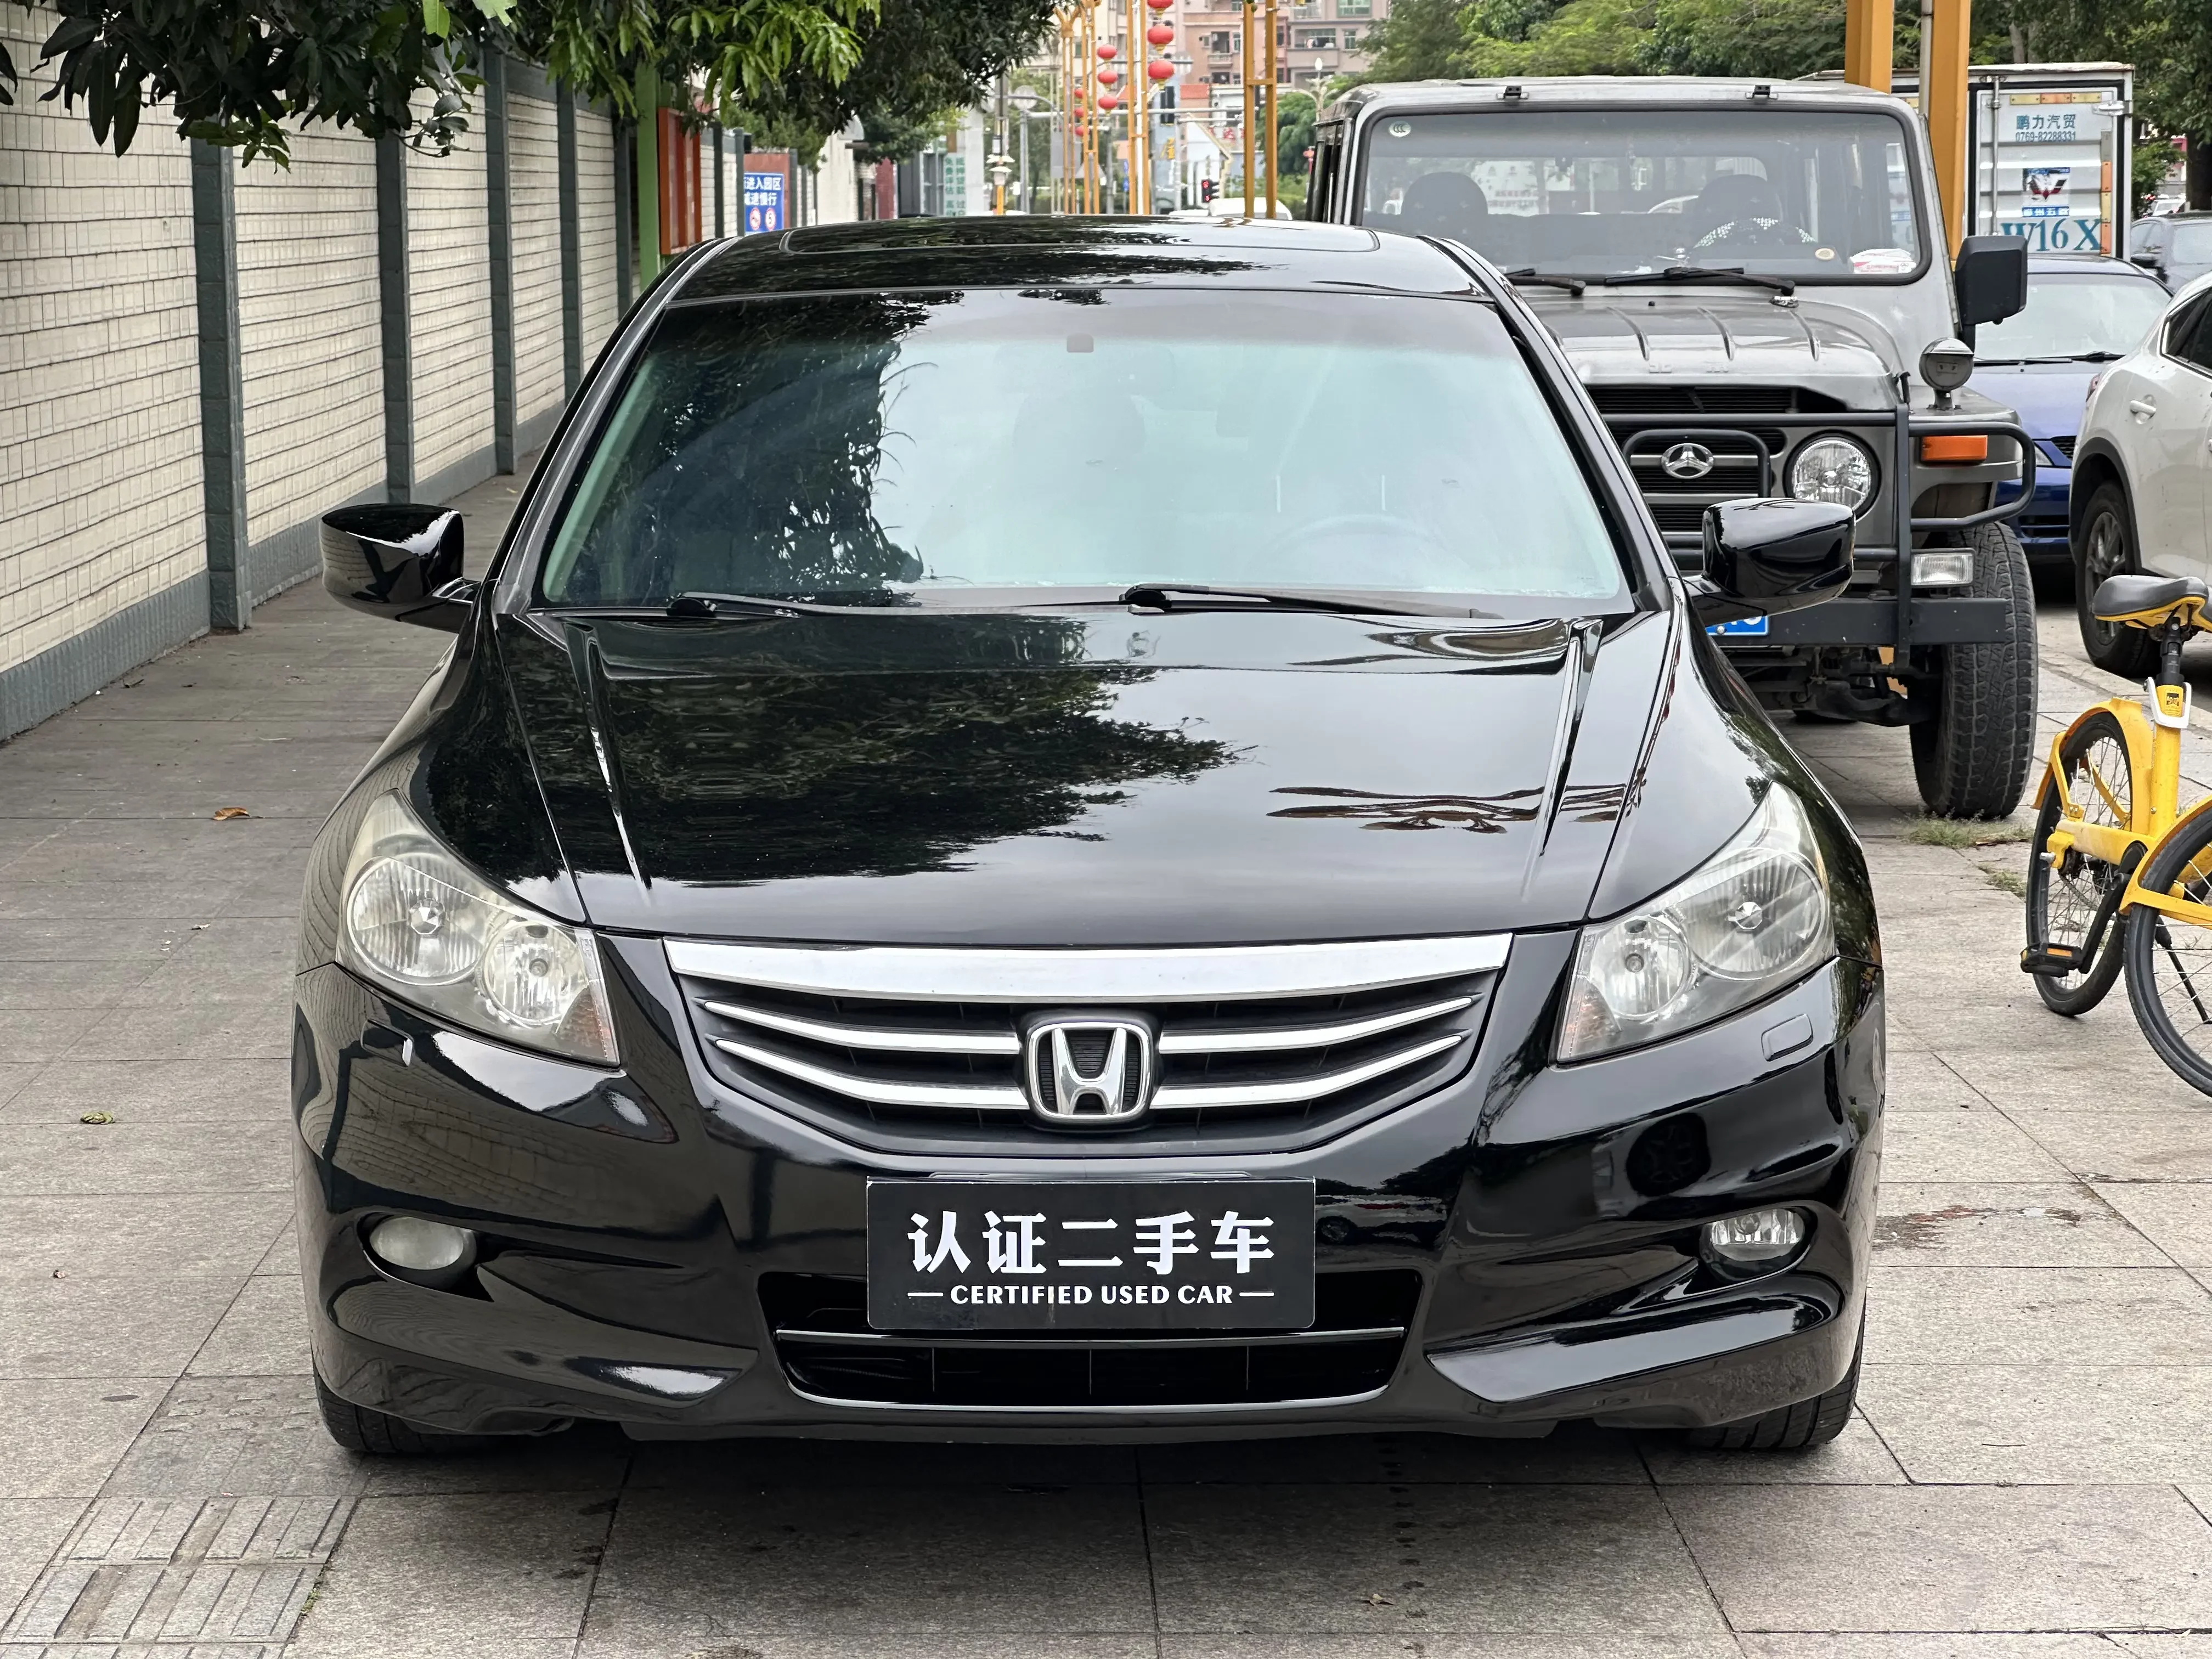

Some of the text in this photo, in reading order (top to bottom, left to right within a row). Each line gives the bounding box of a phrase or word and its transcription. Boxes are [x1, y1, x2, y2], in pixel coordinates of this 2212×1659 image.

[743, 176, 781, 190] 进入园区
[907, 1210, 1274, 1275] 认证二手车
[950, 1285, 1233, 1305] CERTIFIED USED CAR
